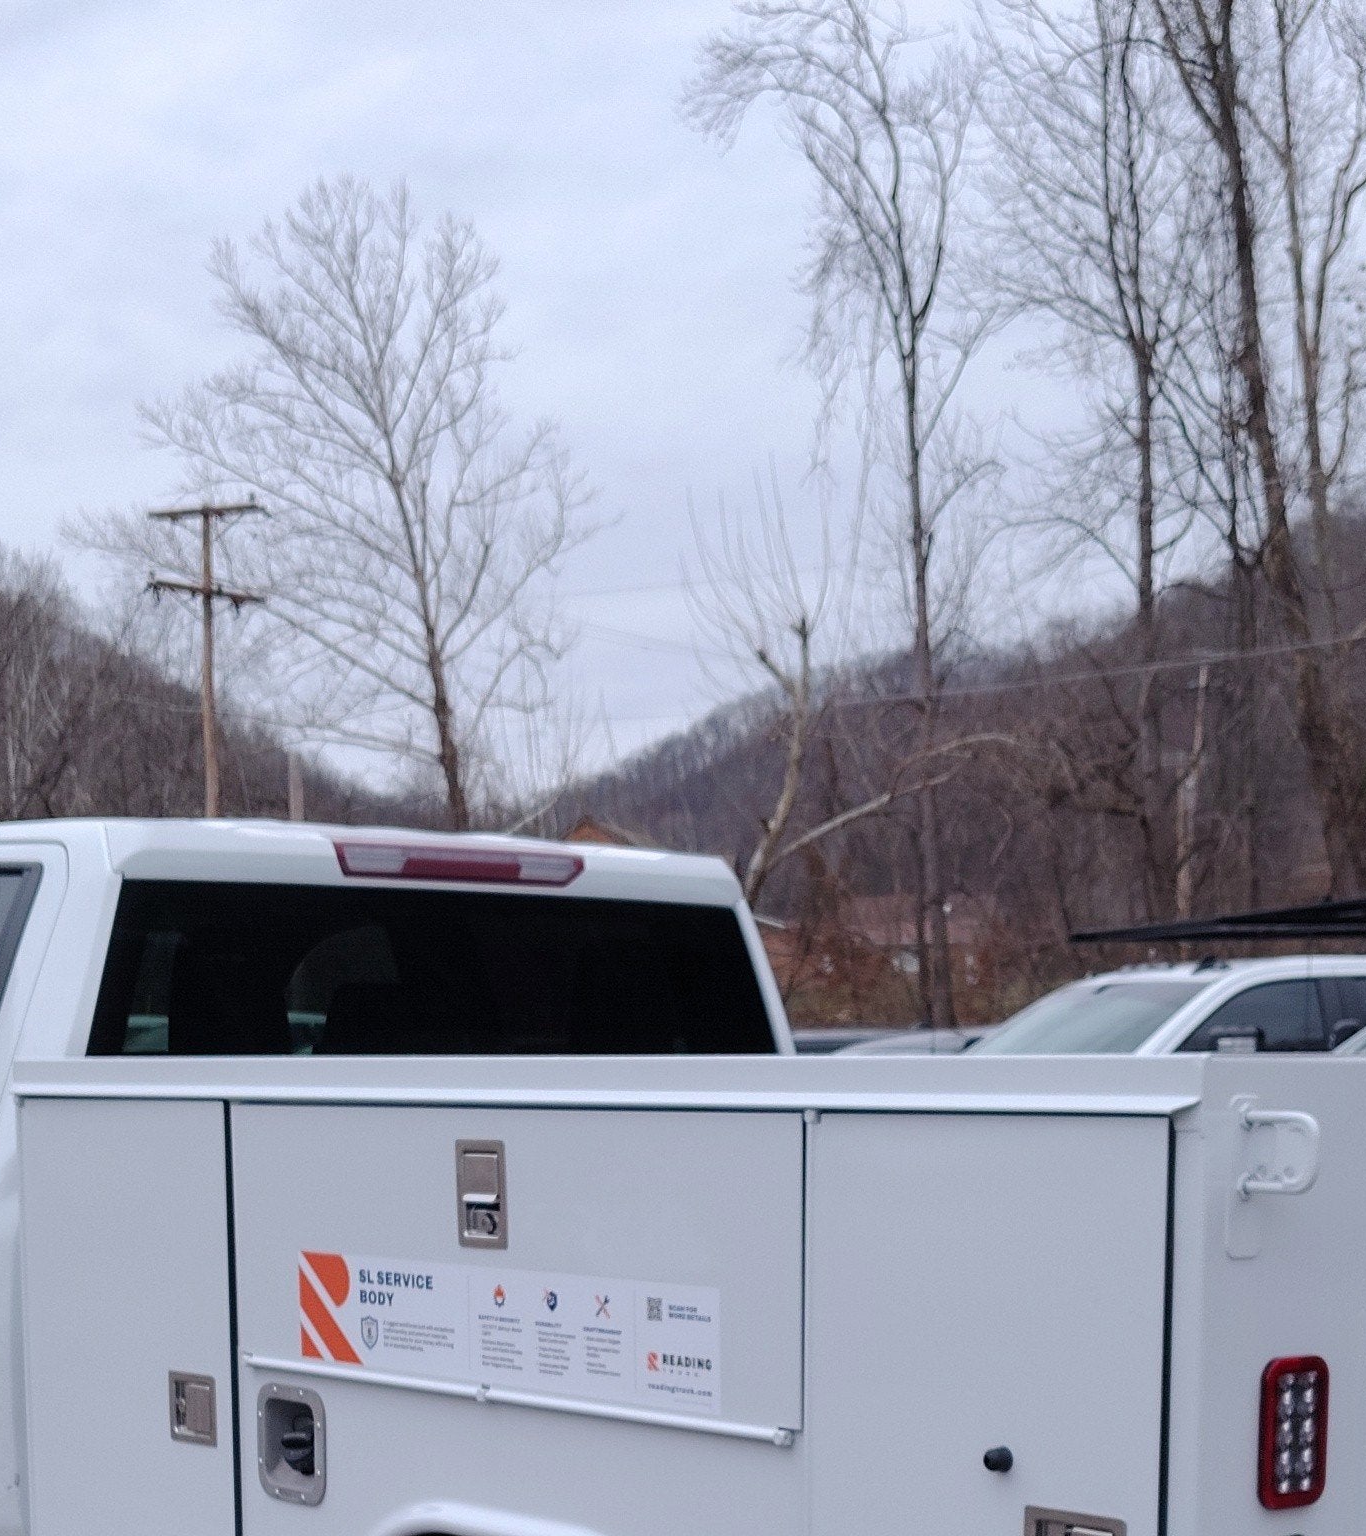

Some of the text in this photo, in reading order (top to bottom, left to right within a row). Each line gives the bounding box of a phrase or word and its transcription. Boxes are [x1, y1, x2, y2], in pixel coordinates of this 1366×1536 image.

[359, 1269, 434, 1290] SL SERVICE
[360, 1290, 394, 1307] BODY
[662, 1353, 713, 1371] READING
